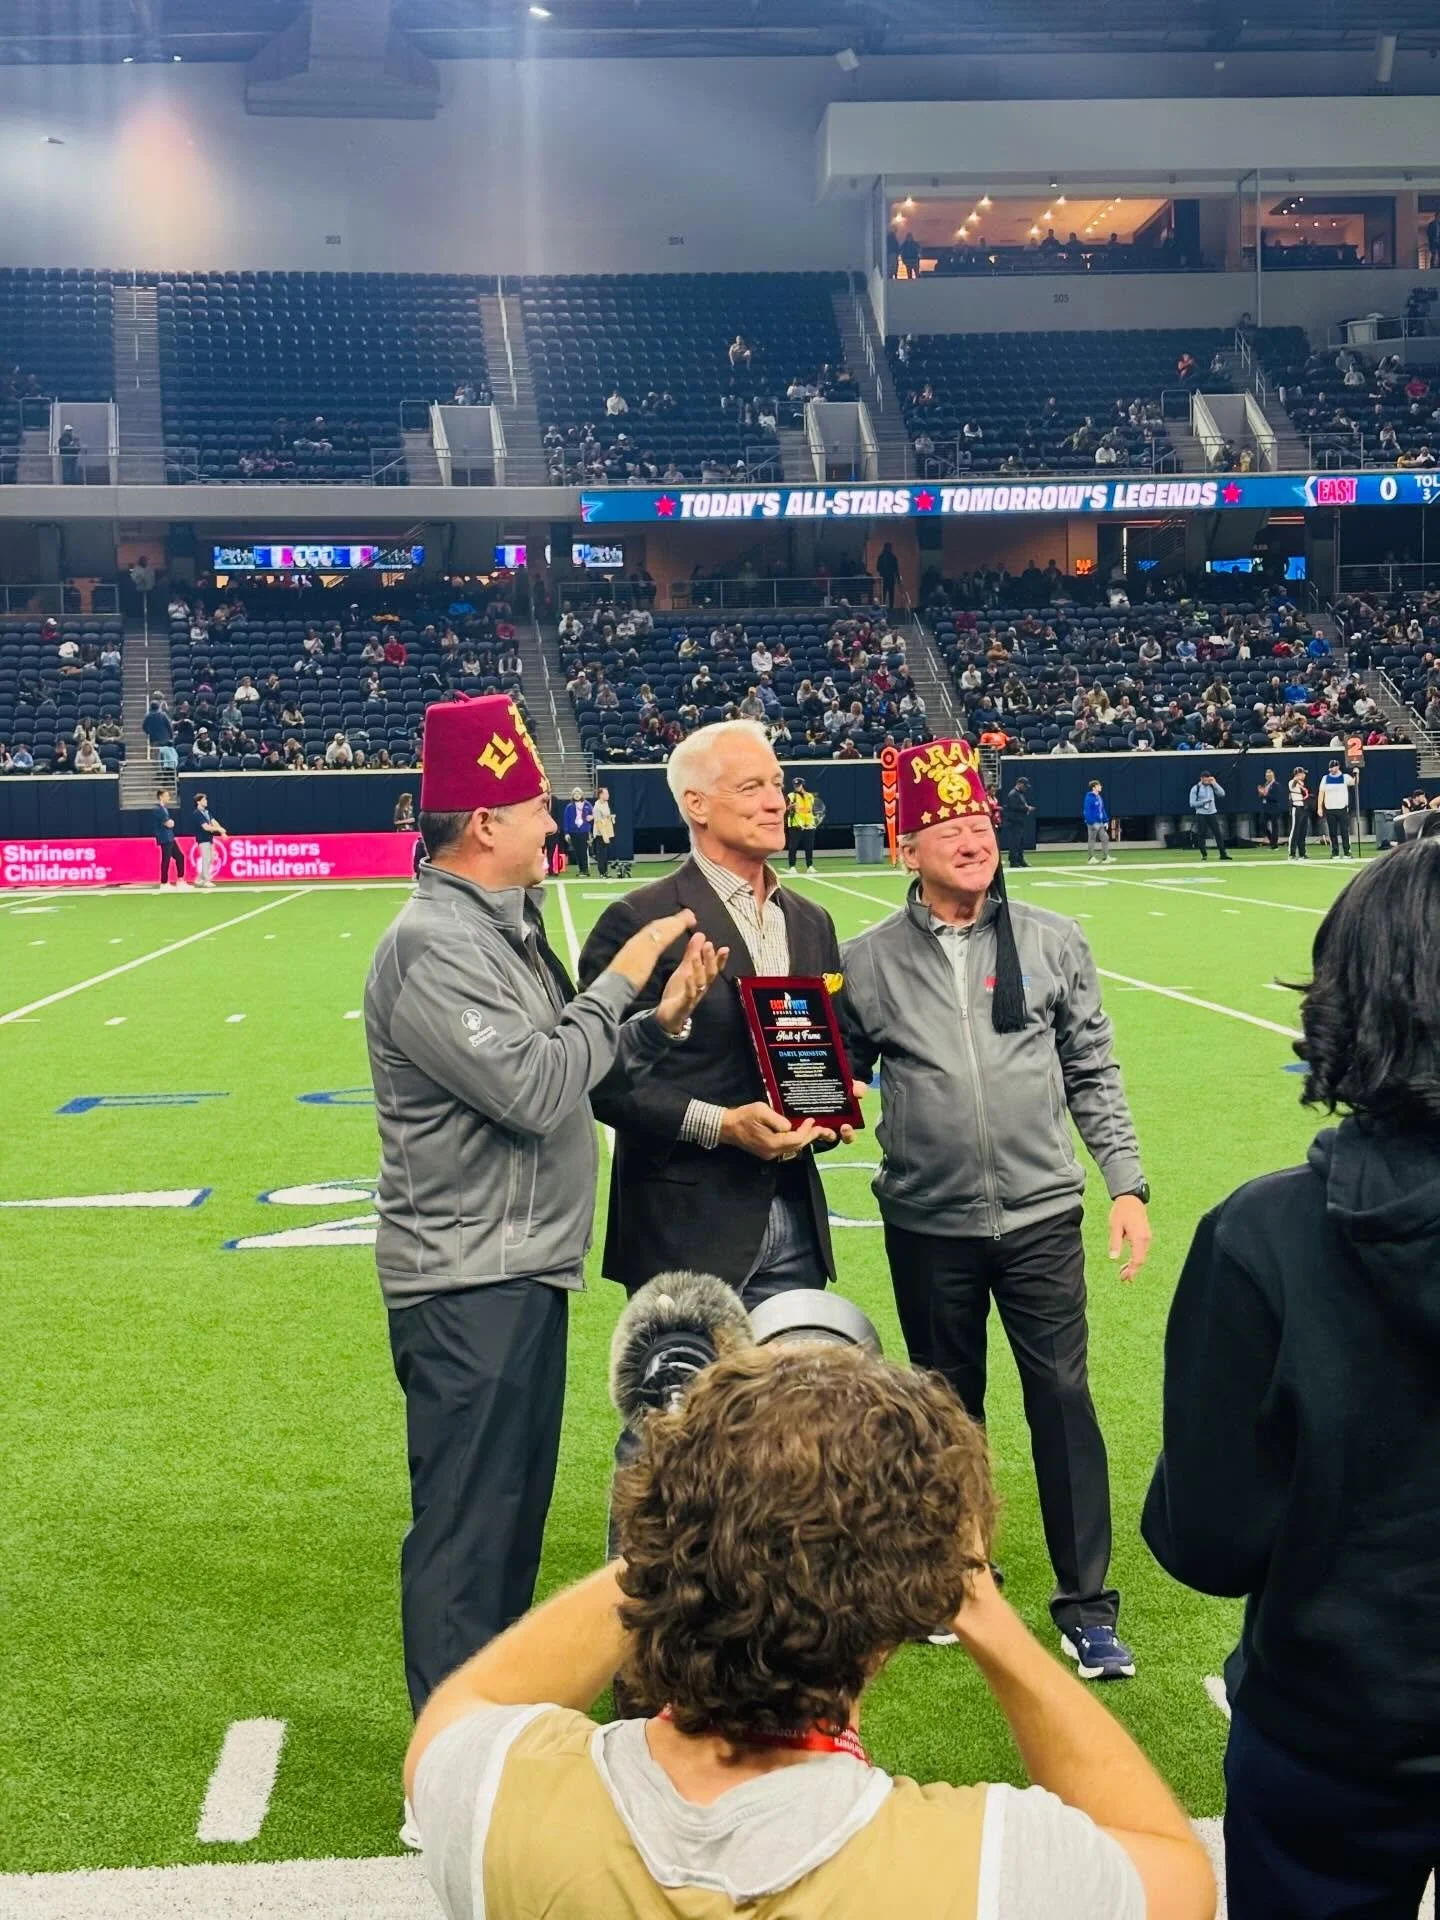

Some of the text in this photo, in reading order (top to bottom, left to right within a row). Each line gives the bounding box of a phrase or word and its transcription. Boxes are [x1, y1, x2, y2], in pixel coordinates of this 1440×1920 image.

[680, 481, 1218, 518] TODAY'S ALL-STARS TOMORROW'S LEGENDS
[1316, 476, 1398, 505] EAST 0
[1347, 737, 1363, 756] 2
[3, 844, 97, 862] Shriners
[230, 840, 320, 858] Shriners
[3, 862, 107, 882] Children's
[230, 858, 330, 877] Children's
[776, 1030, 793, 1041] Hall
[801, 1030, 820, 1041] Fame
